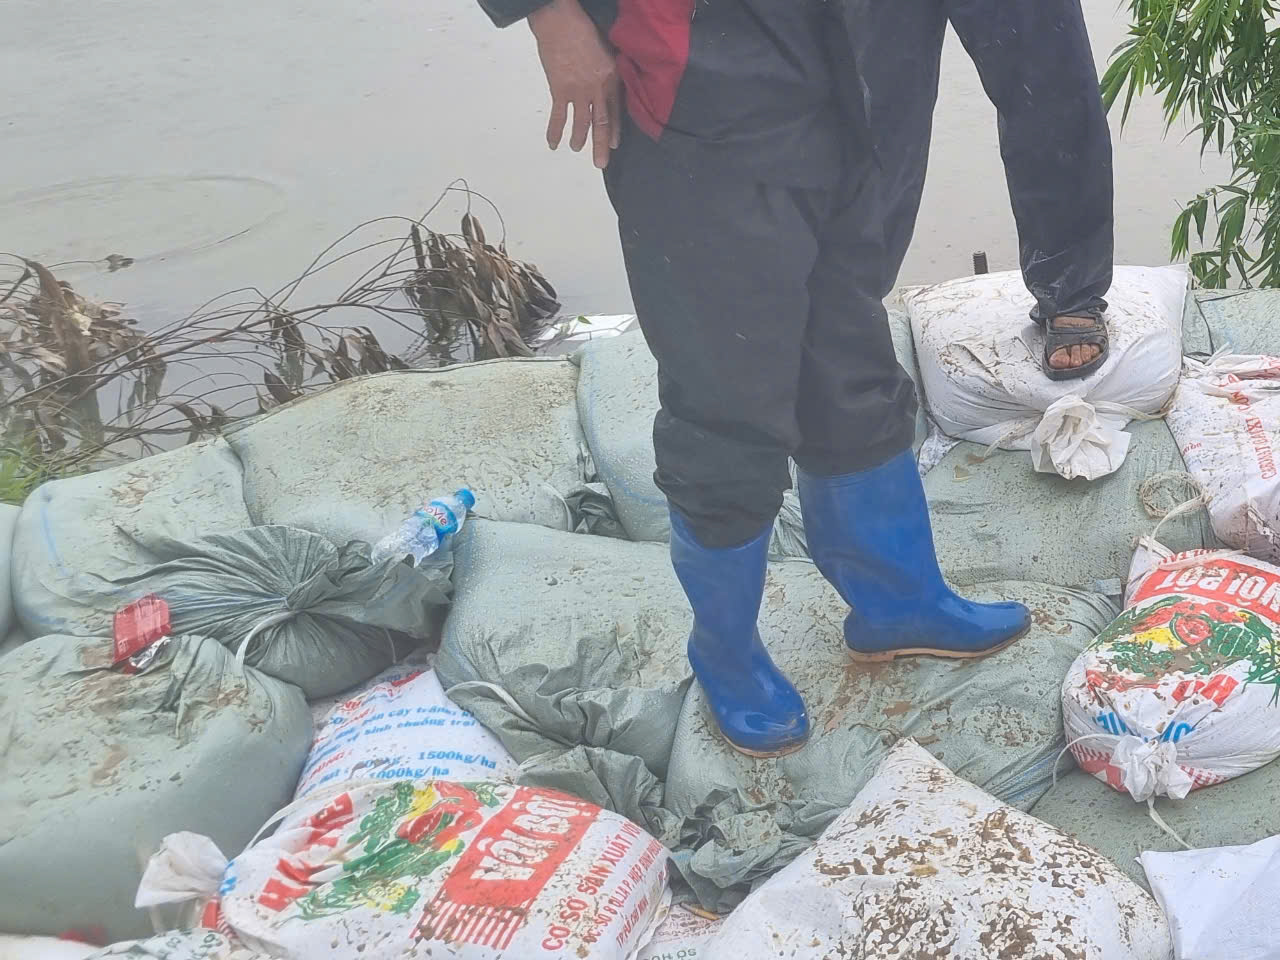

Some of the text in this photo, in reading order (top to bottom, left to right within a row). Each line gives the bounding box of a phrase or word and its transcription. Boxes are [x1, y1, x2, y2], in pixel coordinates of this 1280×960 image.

[417, 750, 497, 770] 1500kg/ha
[469, 827, 560, 882] VÔI
[541, 922, 572, 952] CƠ
[559, 895, 590, 923] SỞ
[575, 861, 615, 896] SẢN
[598, 833, 635, 874] XUẤT
